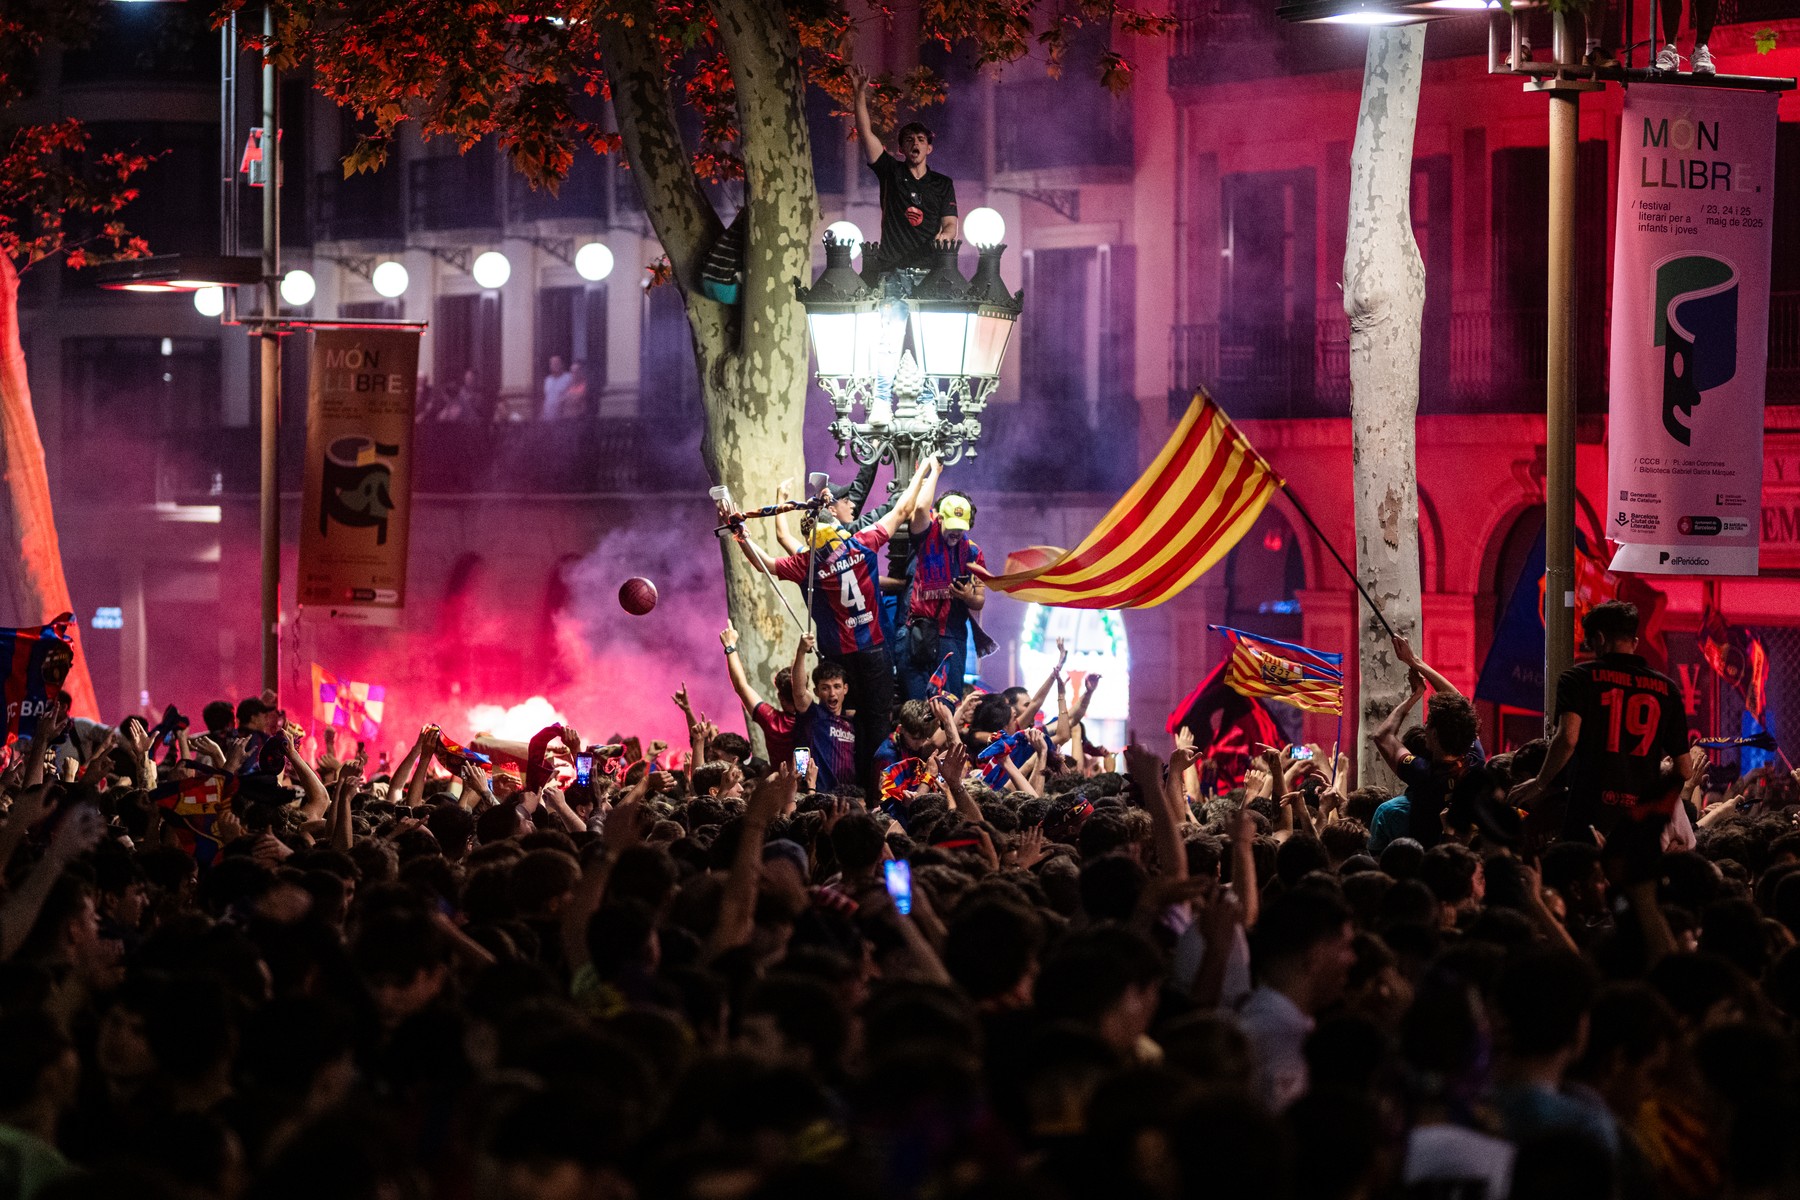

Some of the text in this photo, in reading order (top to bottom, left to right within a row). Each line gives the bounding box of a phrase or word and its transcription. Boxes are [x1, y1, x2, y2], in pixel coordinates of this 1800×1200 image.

[1642, 108, 1720, 151] MÓN
[1639, 200, 1671, 211] festival
[1706, 205, 1720, 215] 23,
[1722, 206, 1733, 215] 24
[1740, 207, 1751, 216] 25
[1638, 212, 1667, 222] literari
[1669, 215, 1683, 224] per
[1706, 217, 1763, 228] maig de 2025
[1638, 222, 1668, 233] infants
[1675, 225, 1698, 235] joves
[326, 342, 380, 369] MÓN
[1639, 466, 1670, 474] Biblioteca
[1671, 467, 1692, 475] Gabriel
[841, 569, 866, 611] 4
[1592, 669, 1670, 697] LAMINE YAMAL
[1601, 687, 1661, 757] 19
